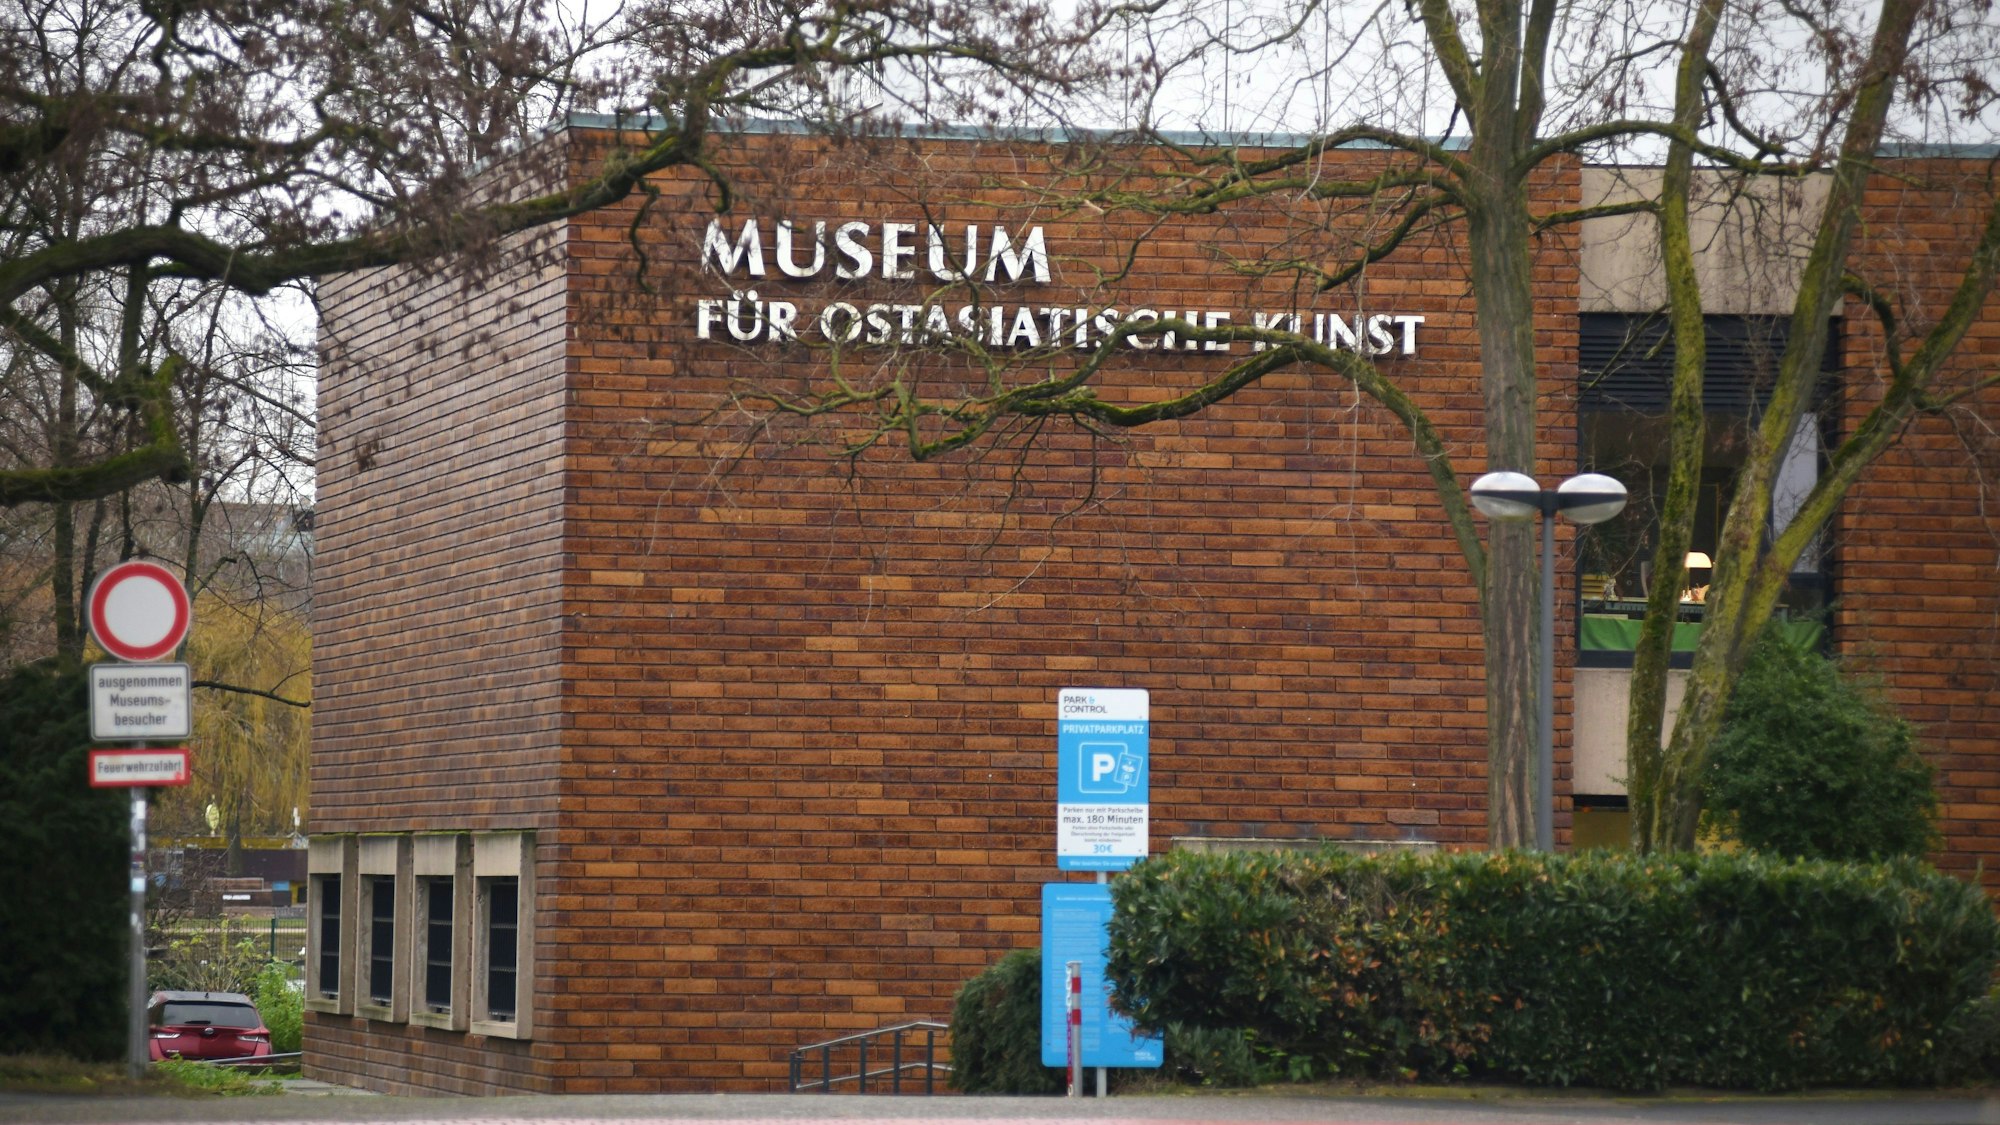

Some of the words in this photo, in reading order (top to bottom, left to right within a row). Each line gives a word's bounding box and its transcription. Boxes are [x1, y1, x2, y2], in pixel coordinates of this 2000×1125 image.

[701, 218, 1052, 283] MUSEUM
[697, 290, 799, 343] FÜR
[820, 301, 1231, 352] OSTASIATISCHE
[1253, 312, 1425, 355] KUNST
[98, 675, 182, 692] ausgenommen
[110, 694, 171, 707] Museums-
[1063, 696, 1088, 704] PARK
[1063, 705, 1108, 713] CONTROL
[114, 712, 167, 726] besucher
[1062, 724, 1144, 735] PRIVATPARKPLATZ
[97, 760, 182, 775] Feuerwehrzufahrt
[1092, 753, 1116, 782] P
[1063, 816, 1085, 824] max.
[1087, 815, 1105, 824] 180
[1107, 815, 1144, 824] Minuten
[1093, 844, 1113, 853] 30€
